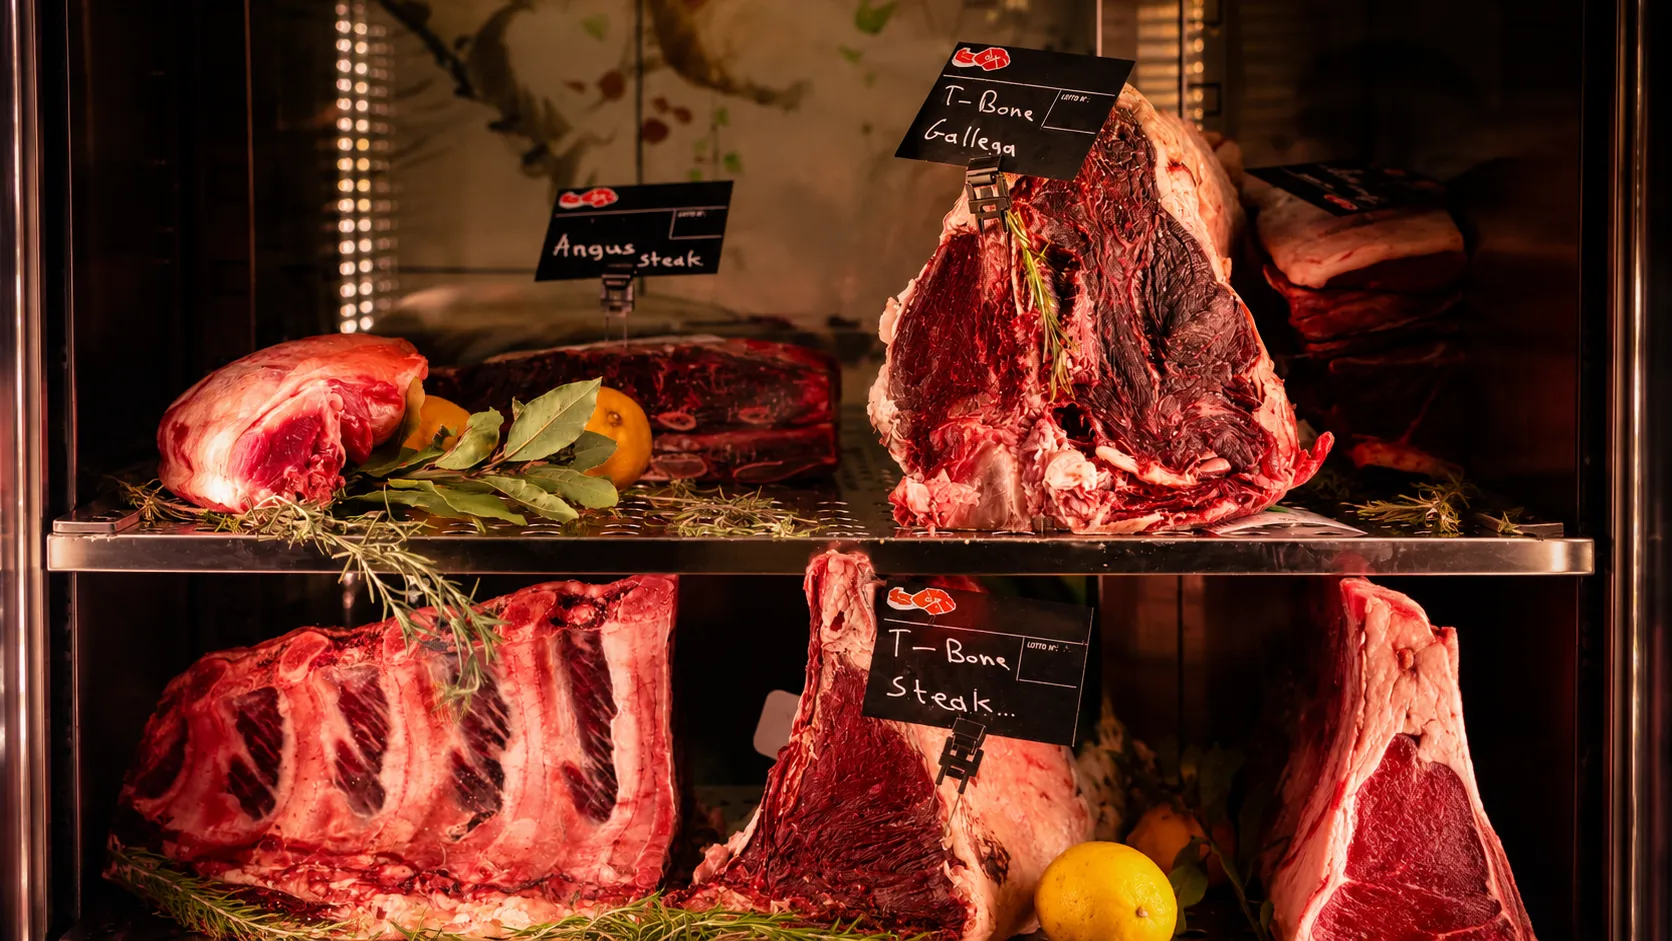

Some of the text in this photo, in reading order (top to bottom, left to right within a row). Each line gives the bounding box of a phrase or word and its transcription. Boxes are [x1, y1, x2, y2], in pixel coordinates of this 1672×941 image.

[923, 118, 1017, 157] Gallega
[552, 233, 636, 261] Angus
[1026, 641, 1047, 650] LOTTO
